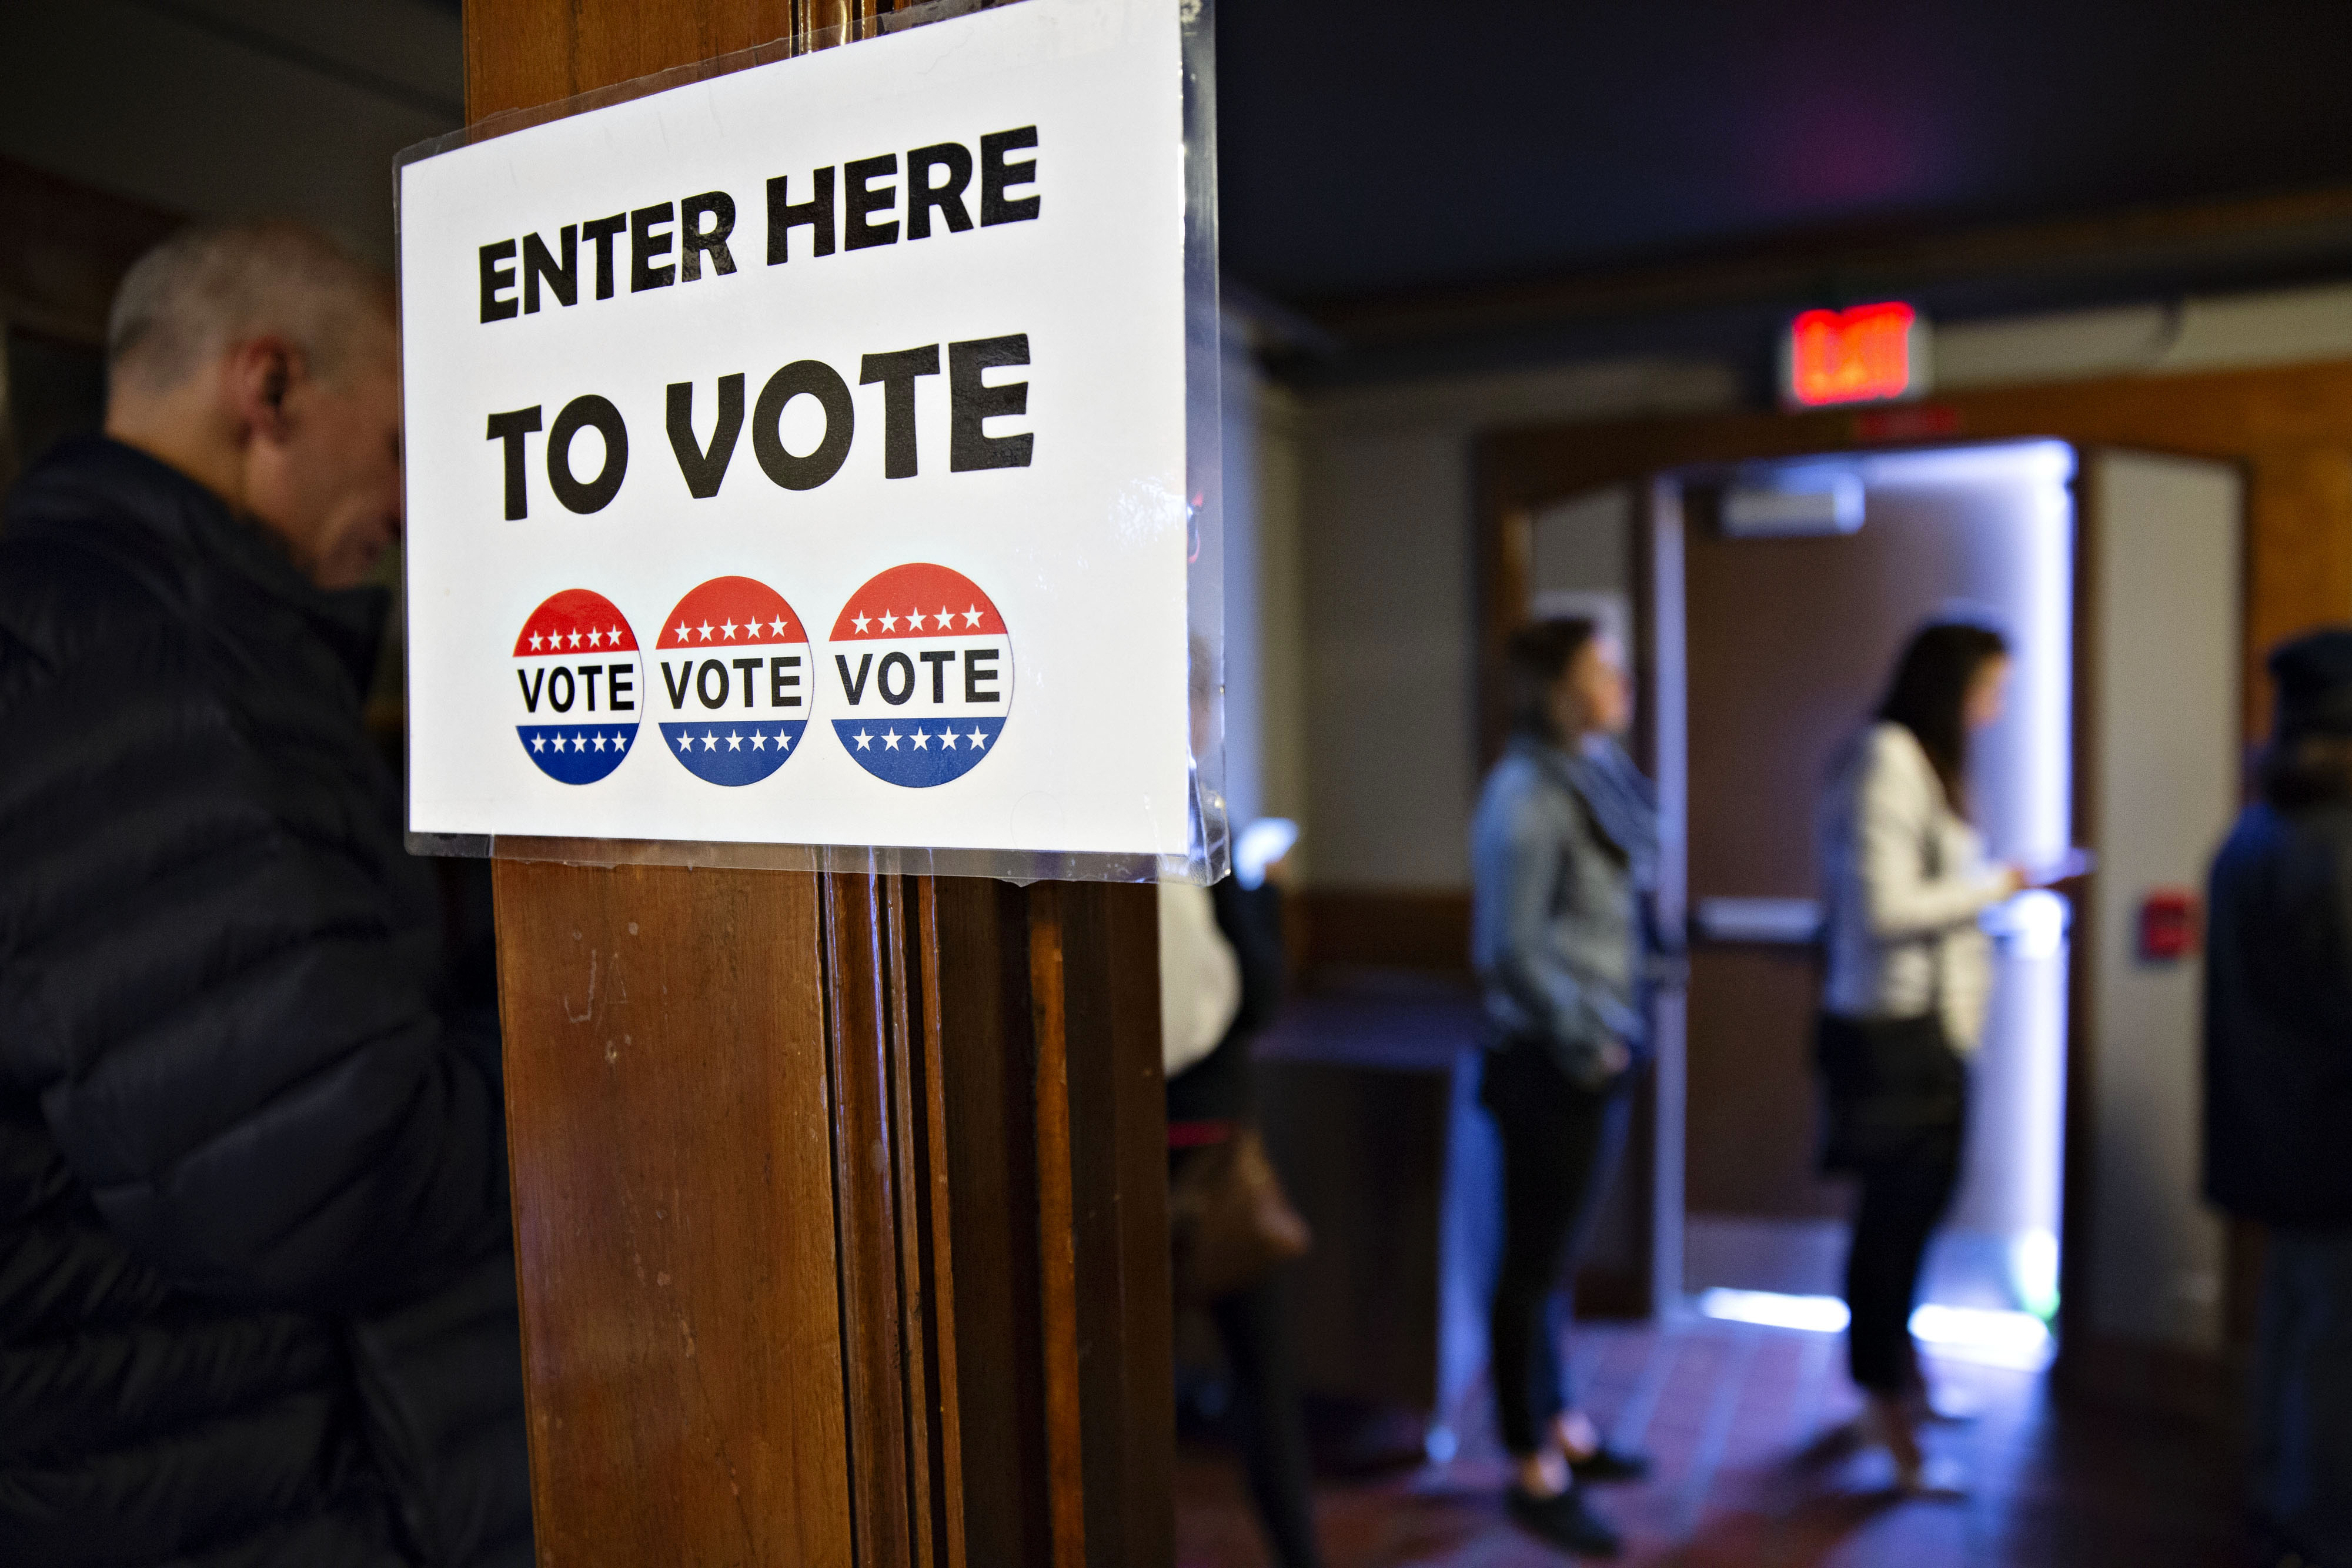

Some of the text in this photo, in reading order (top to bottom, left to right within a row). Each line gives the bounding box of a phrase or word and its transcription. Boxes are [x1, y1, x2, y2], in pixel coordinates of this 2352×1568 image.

[479, 126, 1040, 323] ENTER HERE
[487, 334, 1034, 520] TO VOTE
[518, 664, 634, 713] VOTE
[661, 657, 801, 709] VOTE
[835, 649, 1000, 705] VOTE
